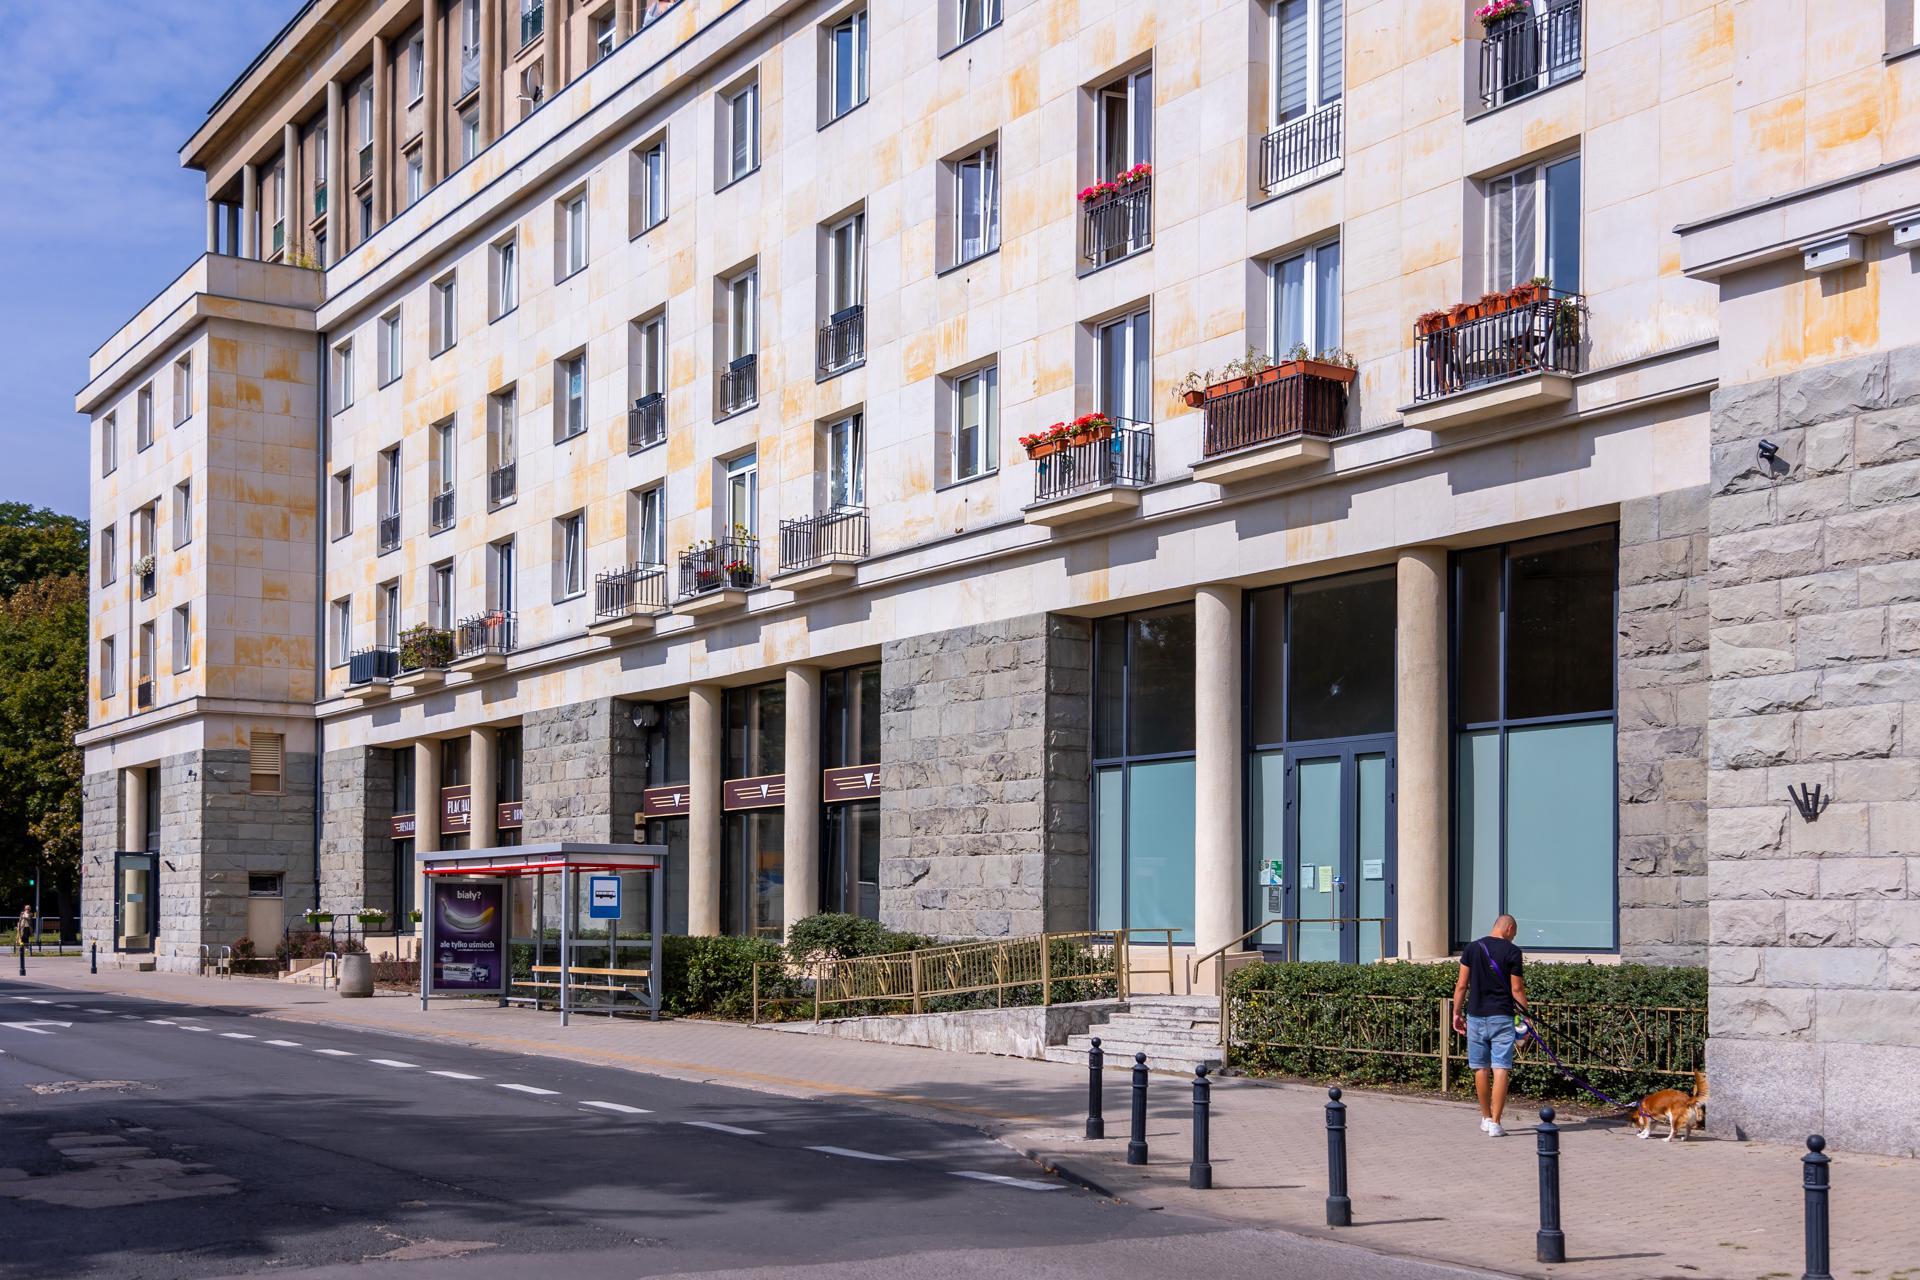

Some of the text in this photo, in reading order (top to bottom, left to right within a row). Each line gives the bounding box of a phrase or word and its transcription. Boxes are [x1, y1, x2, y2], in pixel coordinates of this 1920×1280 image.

[447, 799, 460, 814] PLAC
[457, 890, 482, 901] biały?
[440, 940, 495, 949] ale tylko uśmiech
